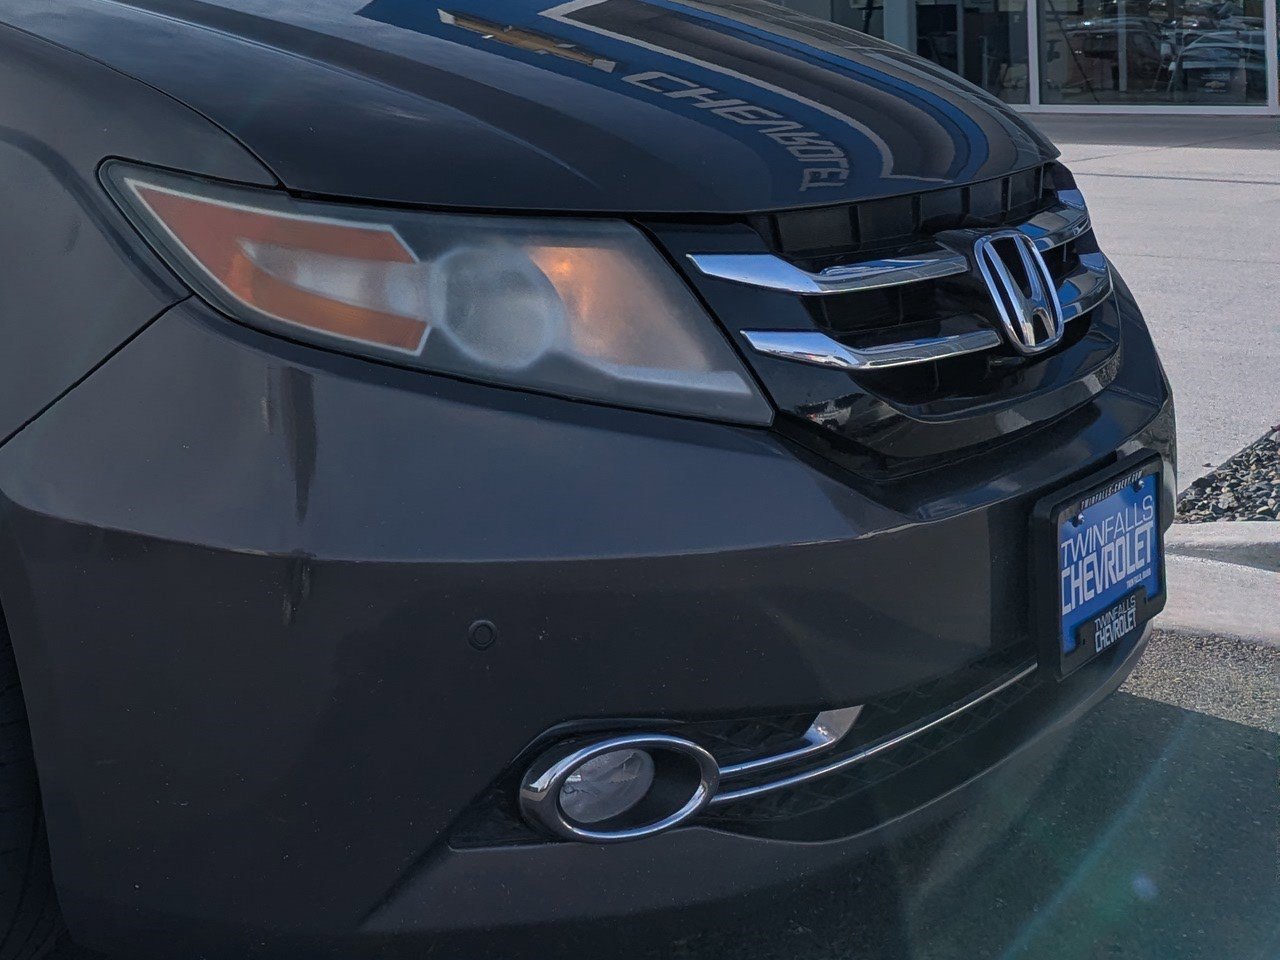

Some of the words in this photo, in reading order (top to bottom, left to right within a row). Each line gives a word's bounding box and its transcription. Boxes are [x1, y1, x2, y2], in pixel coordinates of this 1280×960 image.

[1061, 495, 1154, 566] TWINFALLS
[1061, 520, 1154, 615] CHEVROLET
[1094, 594, 1137, 631] TWINFALLS
[1095, 607, 1137, 653] CHEVROLET
